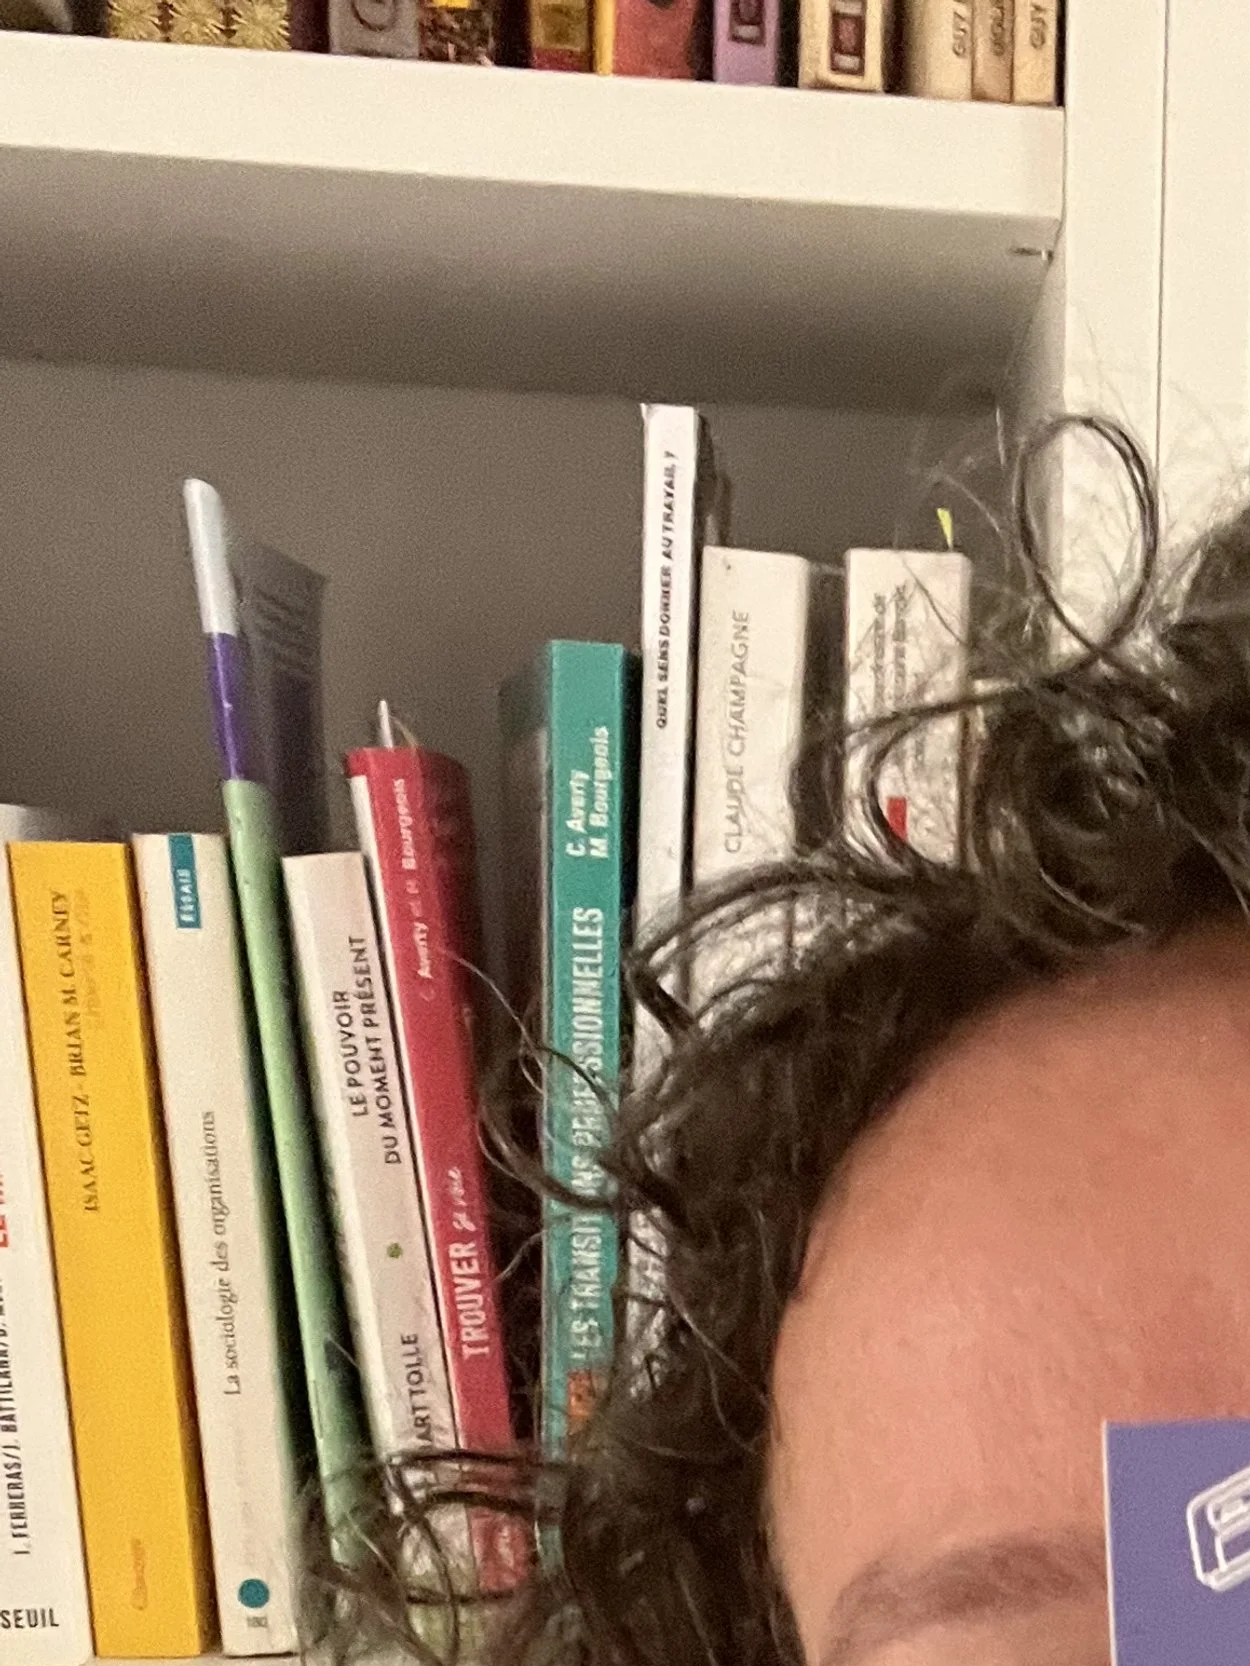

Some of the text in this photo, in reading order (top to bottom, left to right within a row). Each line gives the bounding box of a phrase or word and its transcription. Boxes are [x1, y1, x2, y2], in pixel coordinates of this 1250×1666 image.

[661, 537, 674, 560] AU
[660, 565, 673, 638] DONNER
[658, 639, 671, 684] SENS
[656, 686, 670, 730] QUEL
[724, 609, 749, 854] CLAUDE CHAMPAGNE
[51, 890, 75, 979] CARNEY
[65, 1010, 87, 1077] BRIAN
[333, 990, 369, 1118] LE POUVOIR
[349, 935, 402, 1165] DU MOMENT PRÉSENT
[72, 1093, 92, 1148] GETZ
[78, 1154, 99, 1213] ISAAC
[202, 1111, 241, 1396] La sociologie des organisations
[449, 1240, 490, 1360] TROUVER
[401, 1333, 426, 1396] TOLLE
[0, 1607, 60, 1630] SEUIL
